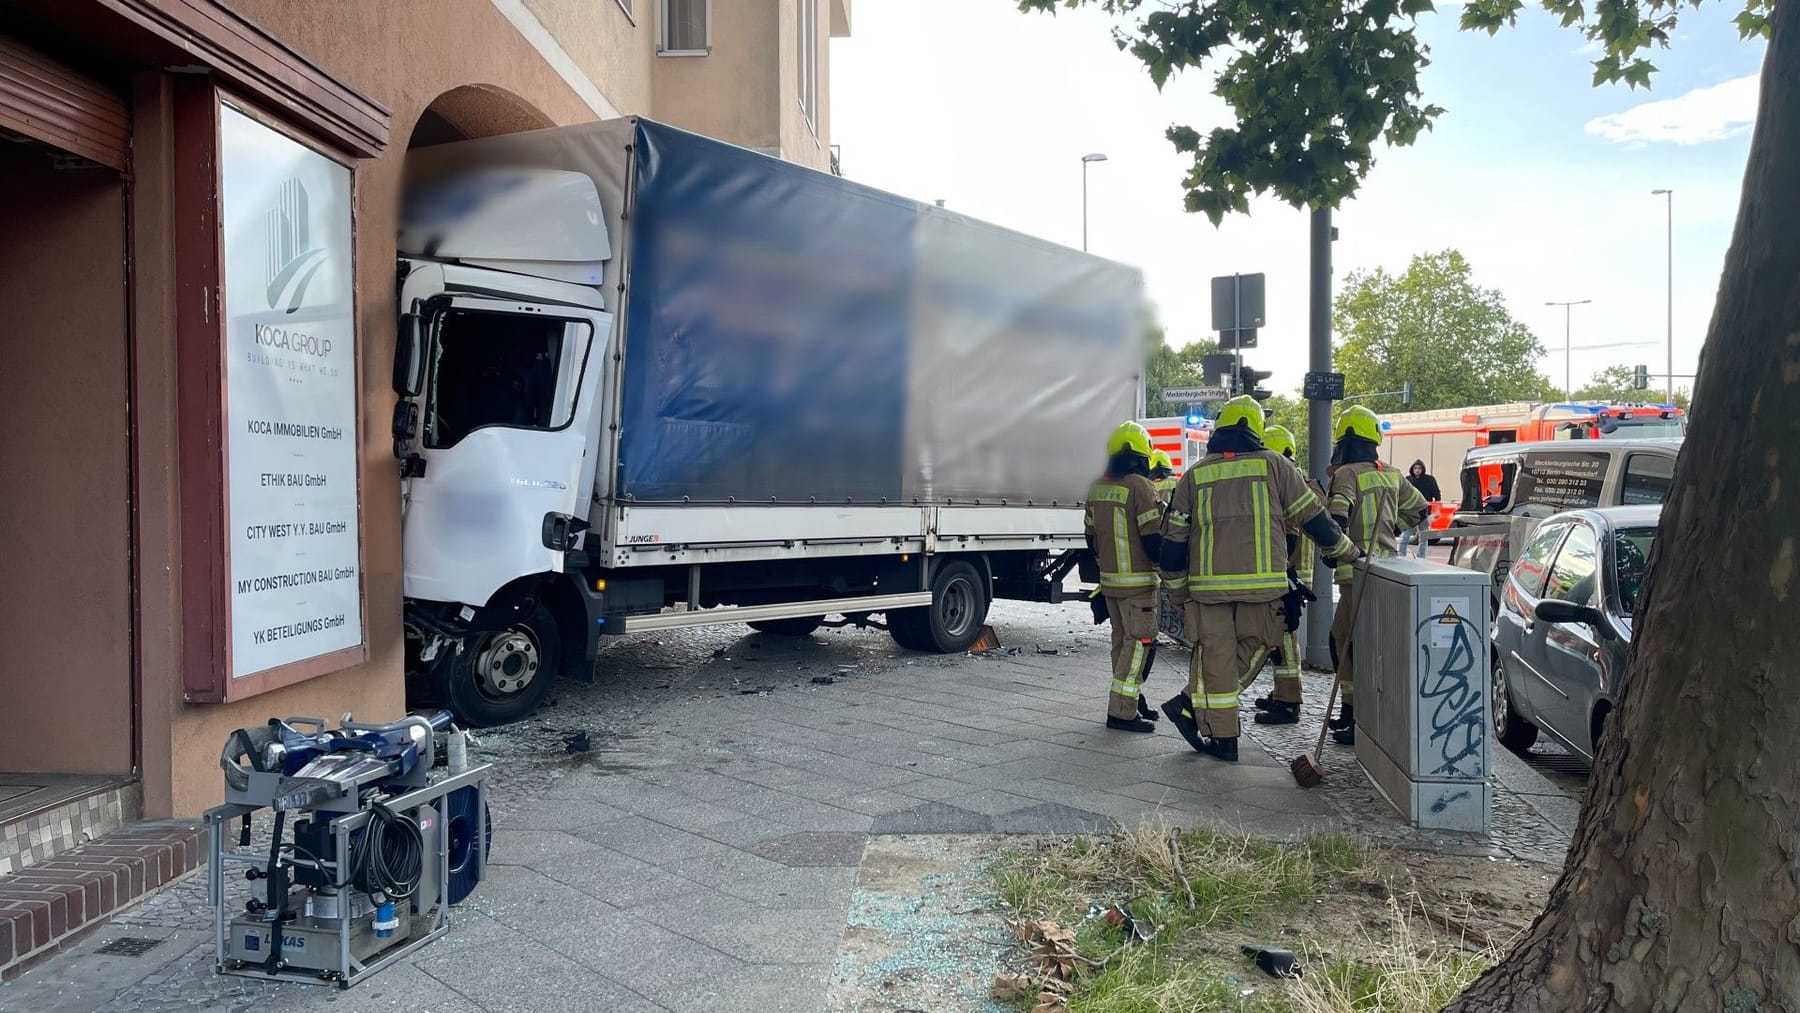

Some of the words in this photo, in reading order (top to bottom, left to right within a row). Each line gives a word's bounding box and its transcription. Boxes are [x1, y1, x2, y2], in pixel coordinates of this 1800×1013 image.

[256, 323, 290, 350] KOCA
[291, 332, 332, 358] GROUP
[247, 352, 284, 368] BUILDING
[287, 360, 296, 370] IS
[248, 420, 272, 435] KOCA
[274, 422, 320, 438] IMMOBILIEN
[320, 427, 342, 440] GmbH
[261, 474, 286, 487] ETHIK
[287, 474, 304, 487] BAU
[304, 474, 326, 487] GmbH
[246, 524, 267, 540] CITY
[268, 524, 291, 538] WEST
[292, 524, 308, 536] Y.Y.
[309, 522, 324, 535] BAU
[325, 521, 346, 534] GmbH
[238, 579, 252, 594] MY
[254, 571, 317, 592] CONSTRUCTION
[318, 570, 333, 583] BAU
[334, 566, 355, 580] GmbH
[253, 630, 266, 645] YK
[267, 620, 323, 642] BETEILIGUNGS
[324, 614, 345, 629] GmbH
[264, 934, 305, 948] LKAS
